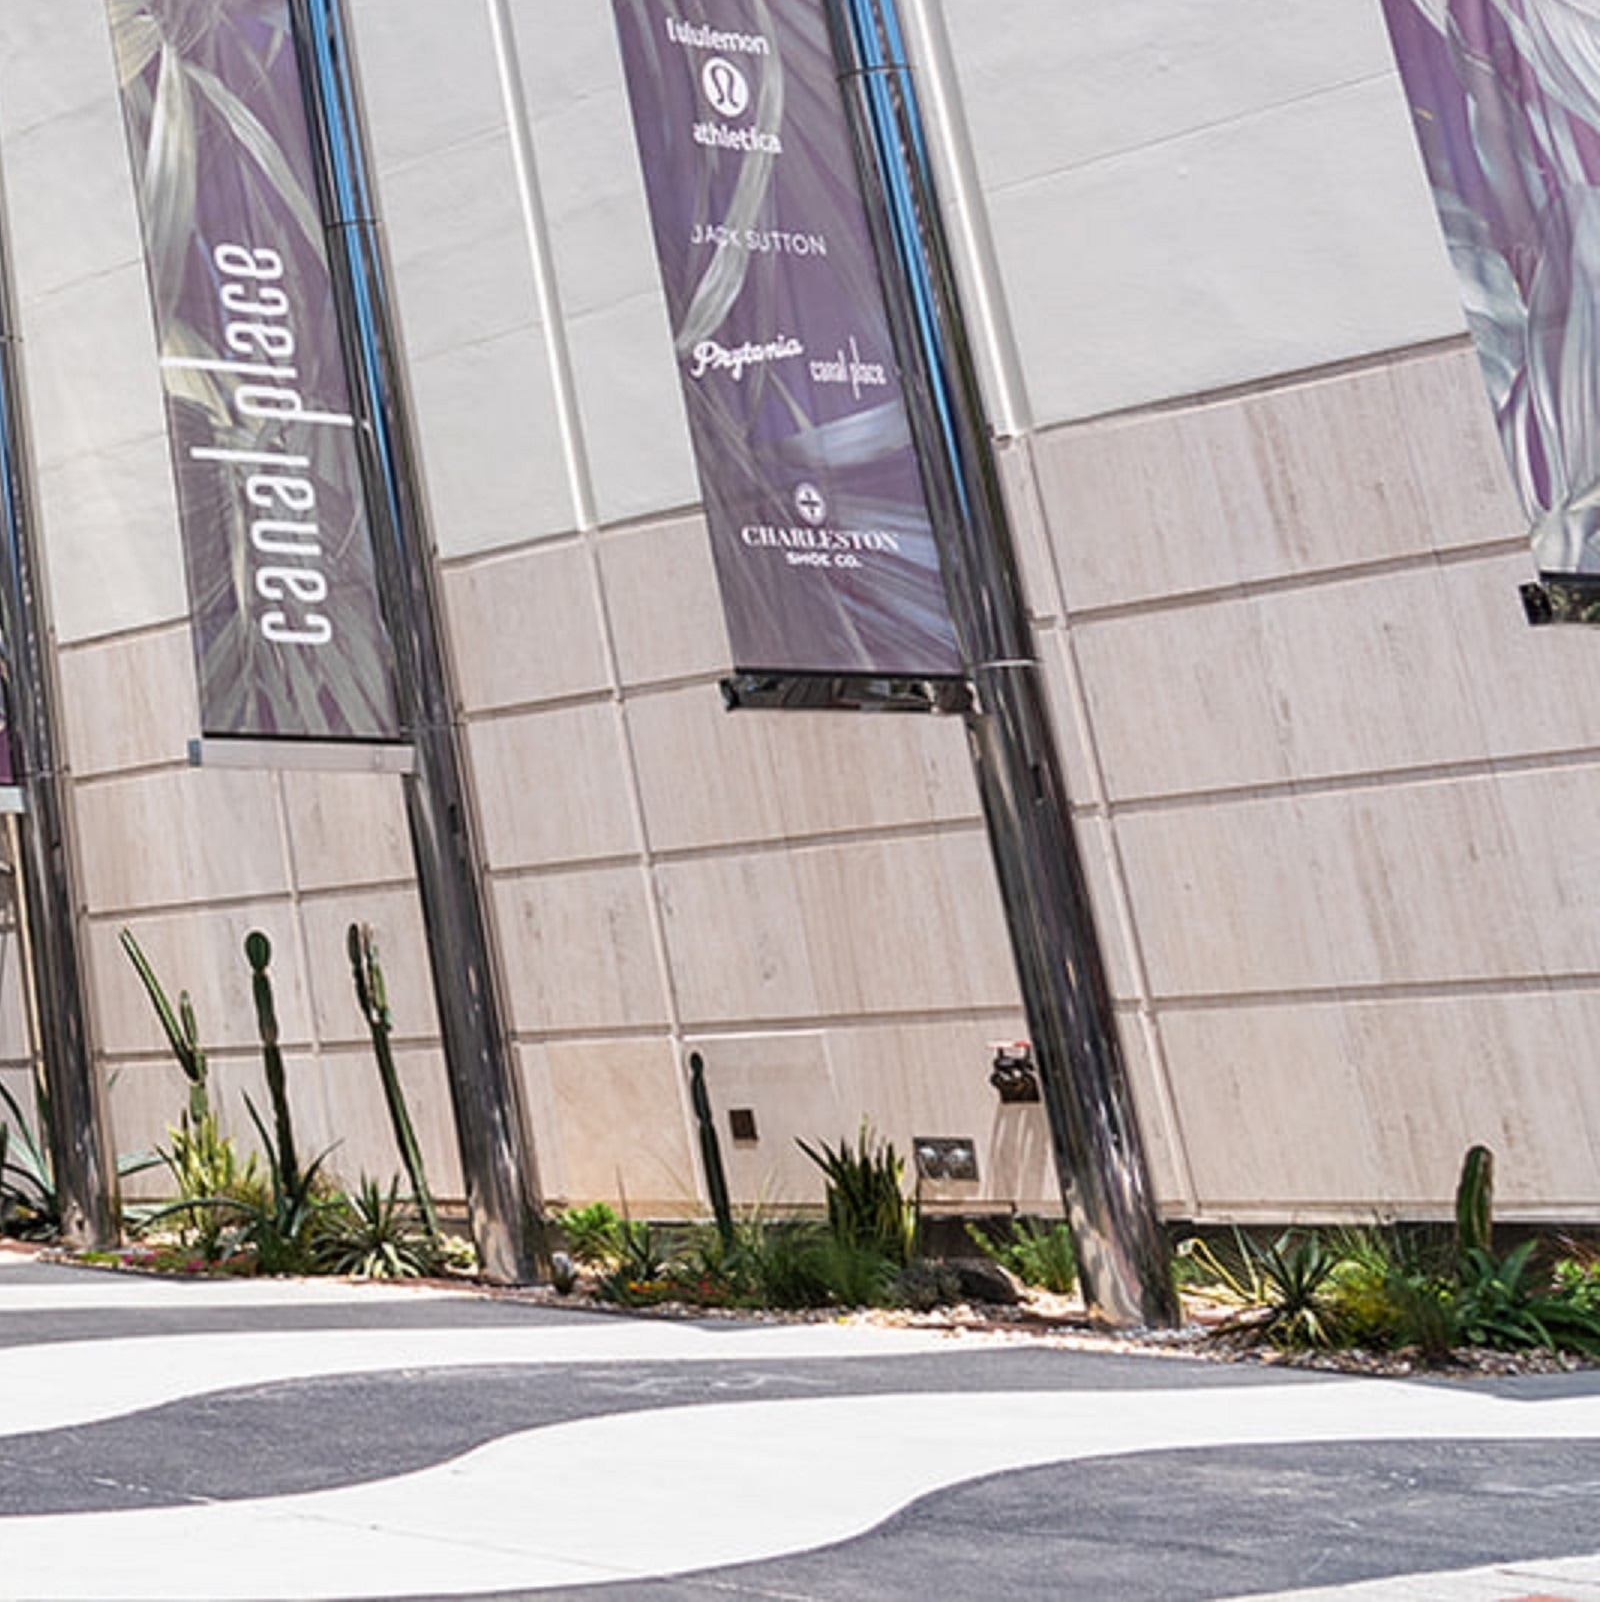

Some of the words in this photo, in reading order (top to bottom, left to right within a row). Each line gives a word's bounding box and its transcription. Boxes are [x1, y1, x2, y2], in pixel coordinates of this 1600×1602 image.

[665, 16, 770, 56] lululemon
[692, 122, 783, 155] athletica
[744, 229, 827, 257] SUTTON
[158, 243, 357, 427] place
[190, 445, 333, 647] canal
[740, 525, 900, 553] CHARLESTON
